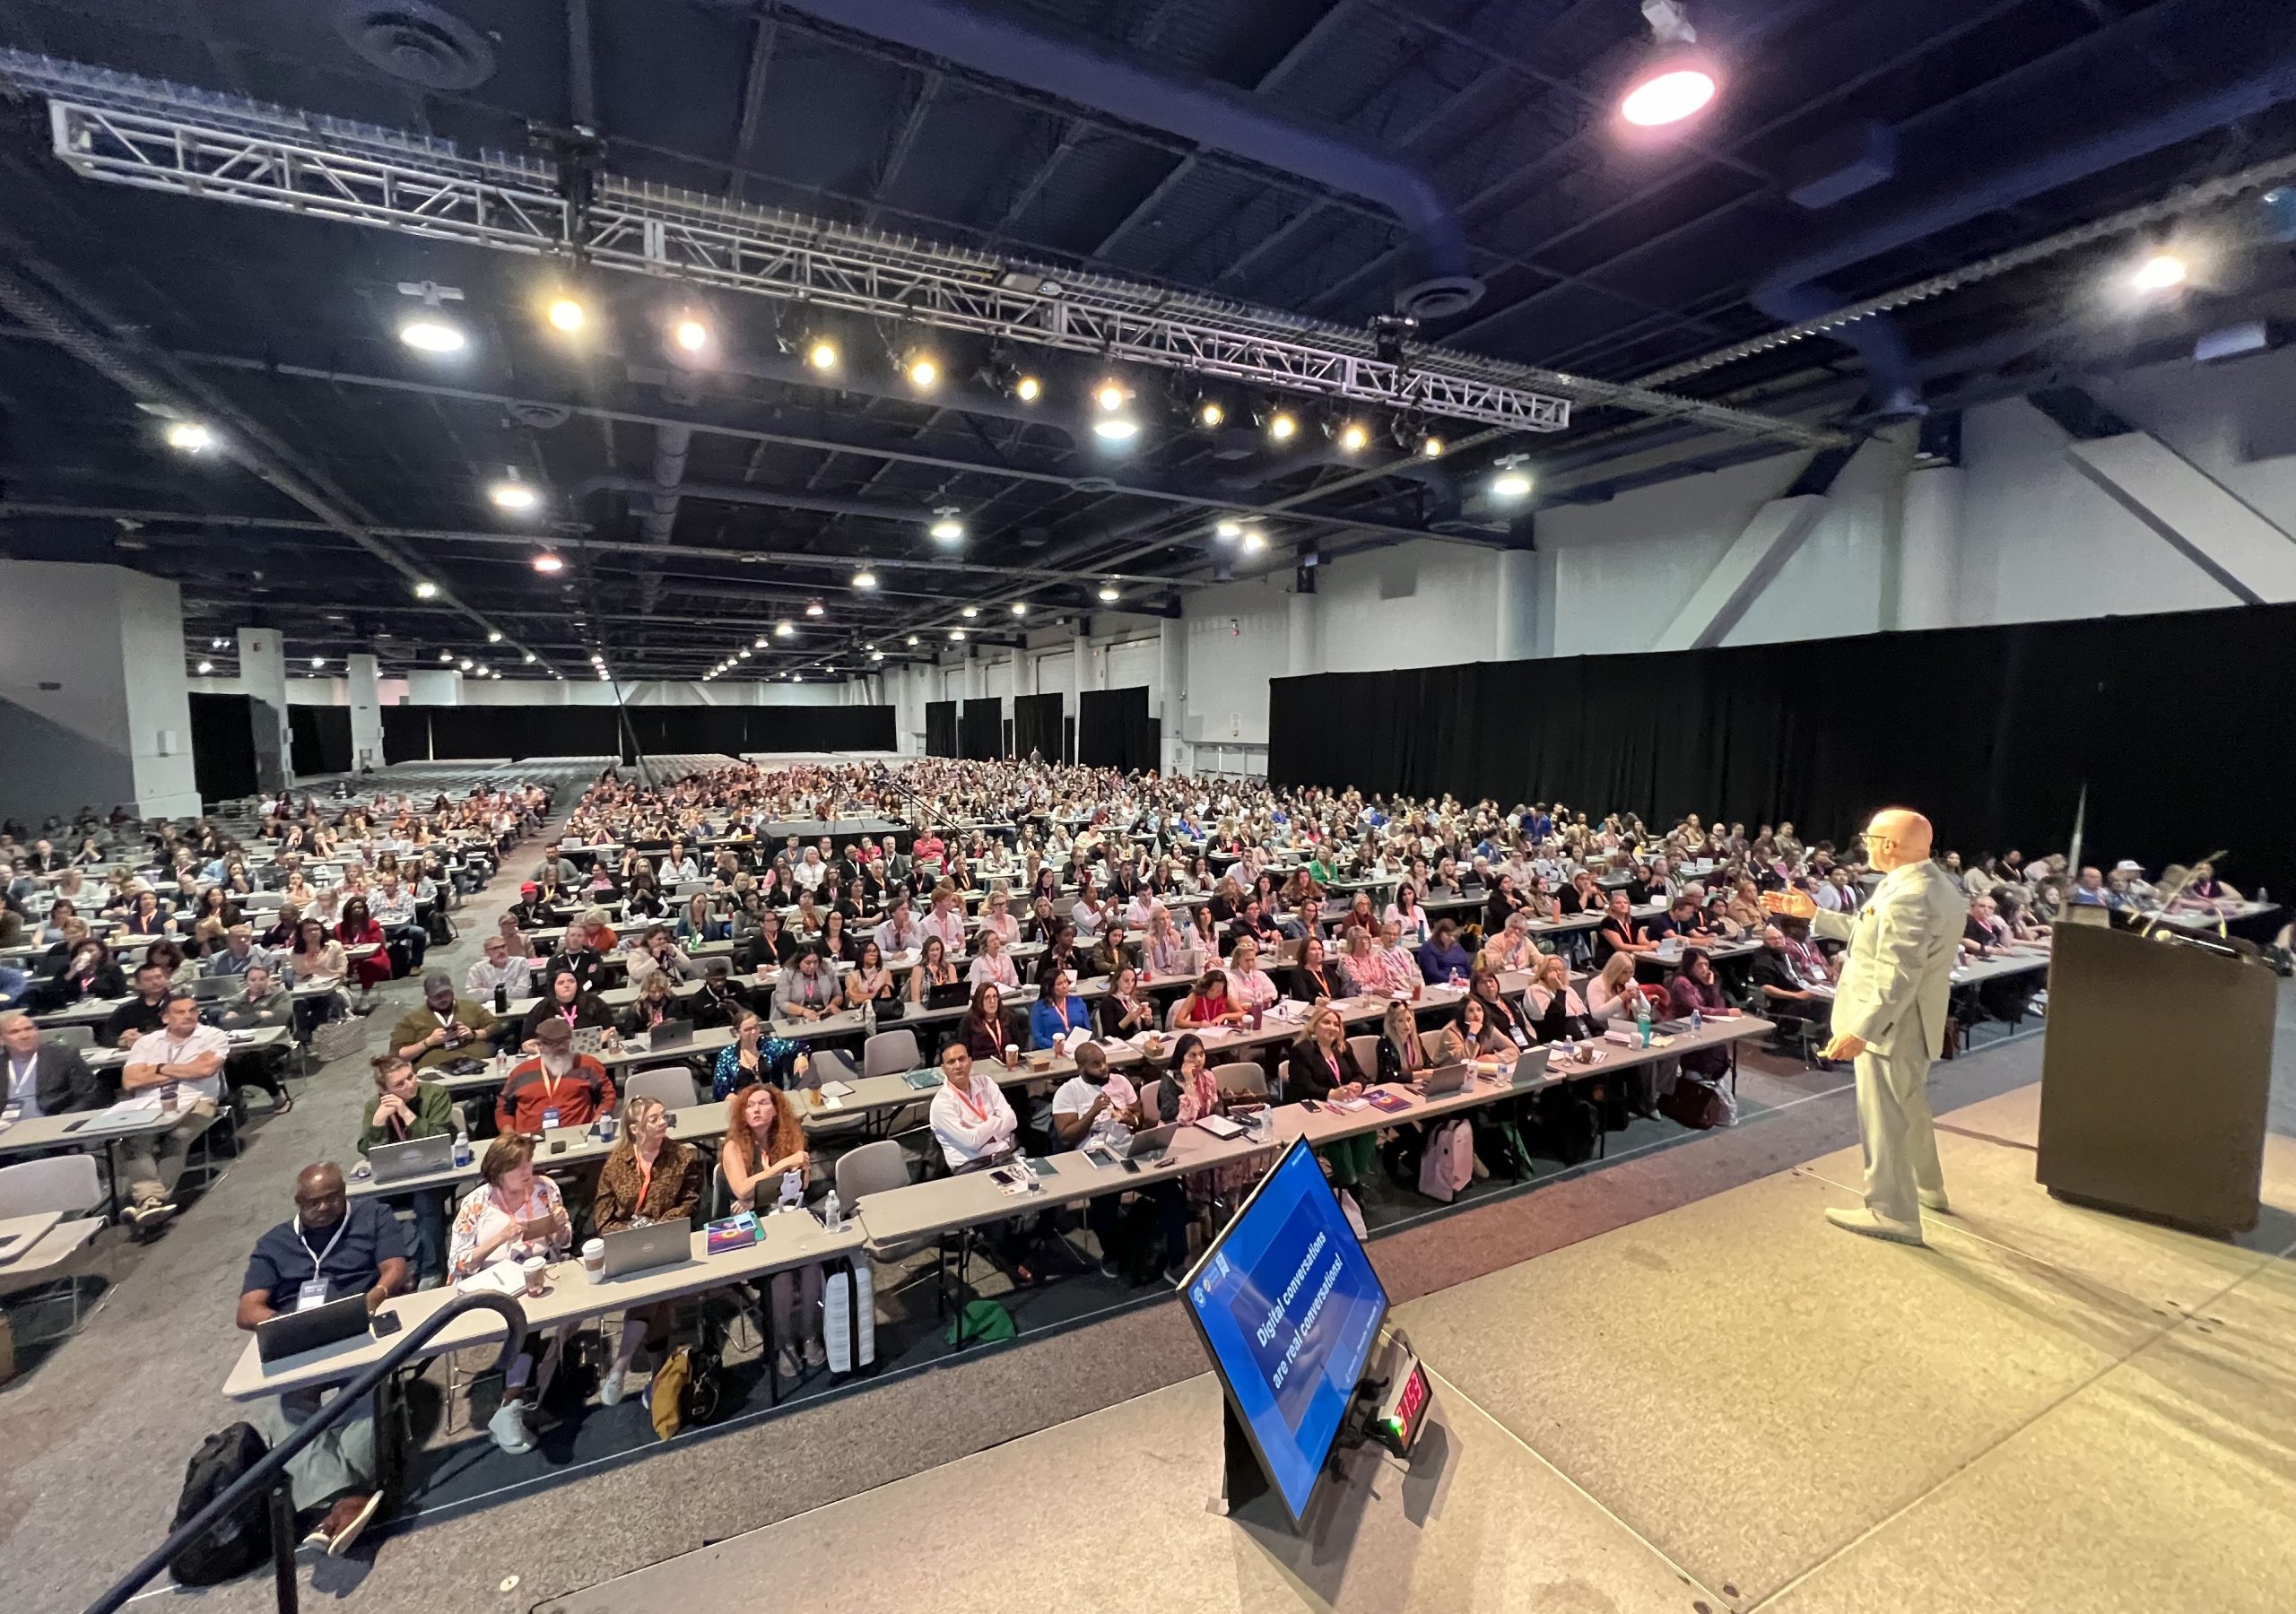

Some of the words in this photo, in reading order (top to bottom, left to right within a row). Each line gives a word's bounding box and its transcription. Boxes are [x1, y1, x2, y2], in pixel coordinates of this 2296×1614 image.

[1257, 1297, 1285, 1348] Digital
[1283, 1231, 1326, 1306] conversations
[1273, 1360, 1289, 1389] are
[1285, 1329, 1303, 1365] real
[1300, 1252, 1344, 1337] conversations!
